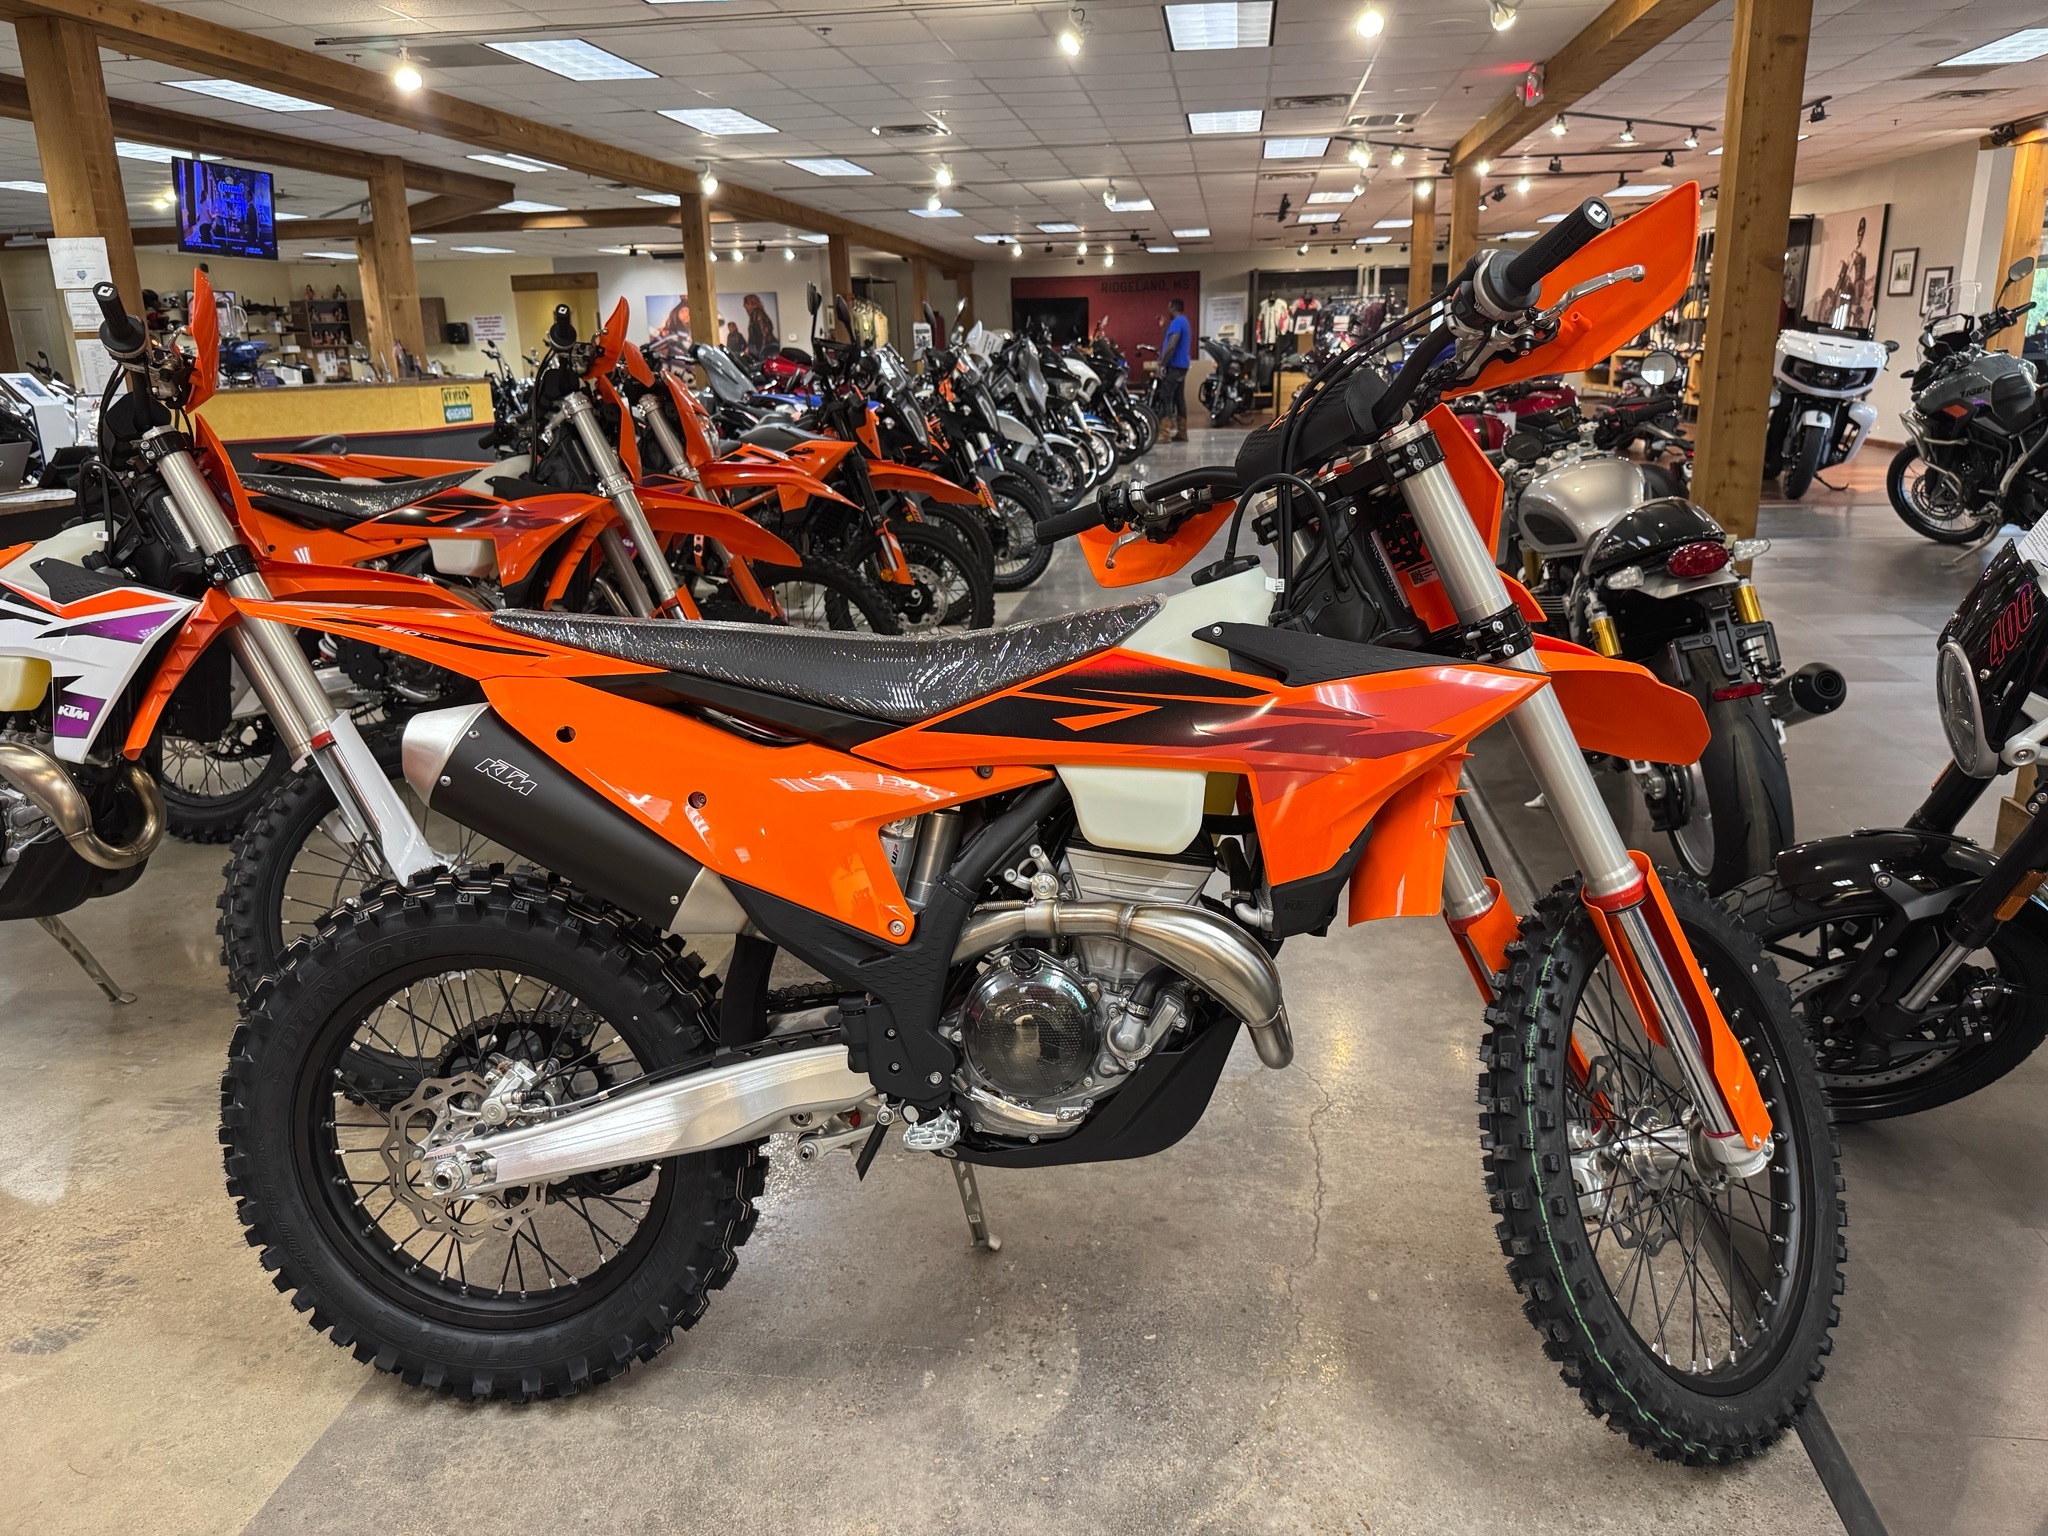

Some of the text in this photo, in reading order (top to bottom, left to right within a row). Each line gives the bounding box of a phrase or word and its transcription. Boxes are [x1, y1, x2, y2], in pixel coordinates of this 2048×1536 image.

[1101, 278, 1190, 294] RIDGELAND, MS
[1960, 385, 1991, 398] TIGER
[1990, 582, 2033, 667] 400
[58, 704, 90, 721] KTM
[474, 757, 538, 796] KTM
[891, 843, 900, 866] WP
[275, 932, 431, 1062] DUNLOP
[1060, 979, 1088, 1010] MOTOREX
